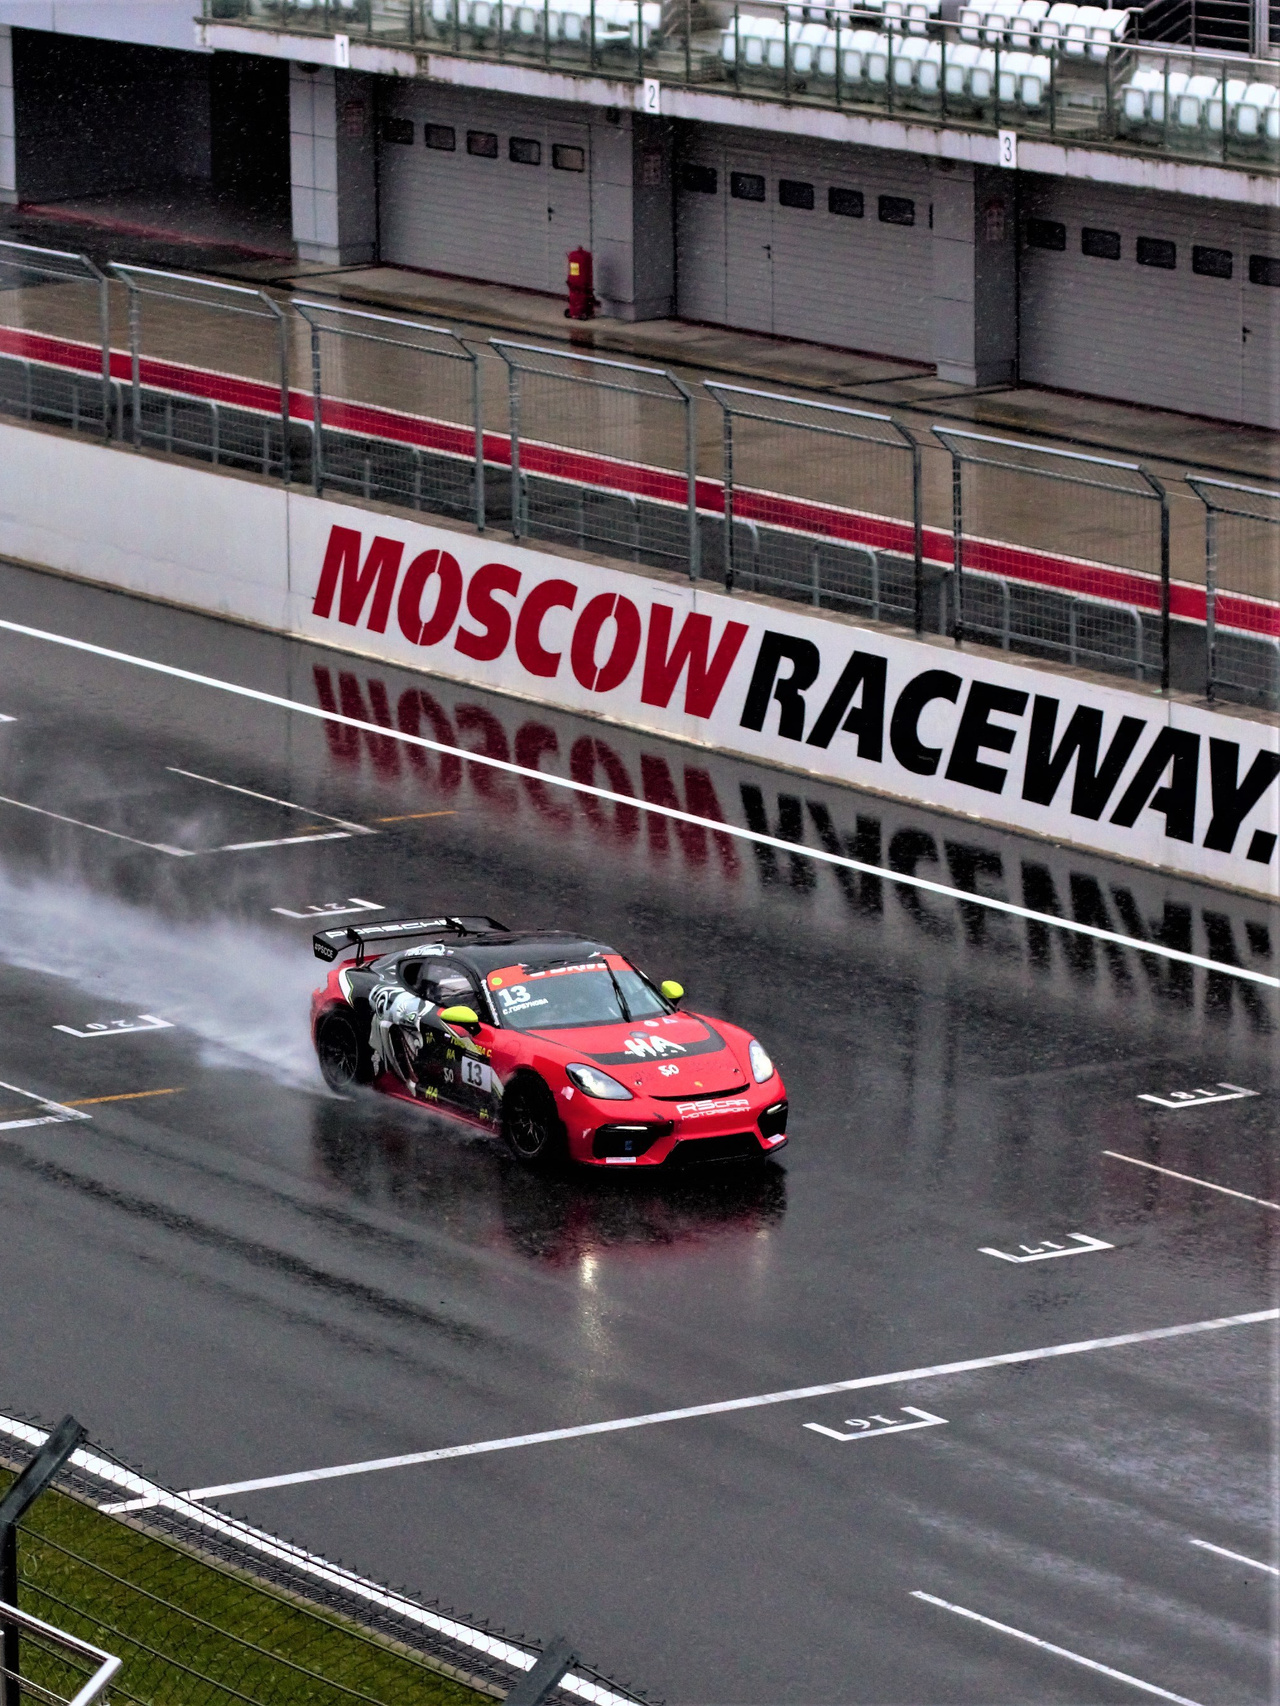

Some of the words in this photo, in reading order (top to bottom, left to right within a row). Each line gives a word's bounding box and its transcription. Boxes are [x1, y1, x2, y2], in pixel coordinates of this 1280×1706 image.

[648, 84, 656, 109] 2
[1004, 136, 1013, 162] 3
[312, 524, 750, 720] MOSCOW
[739, 629, 1280, 865] RACEWAY.
[498, 985, 531, 1007] 13
[467, 1061, 483, 1087] 13
